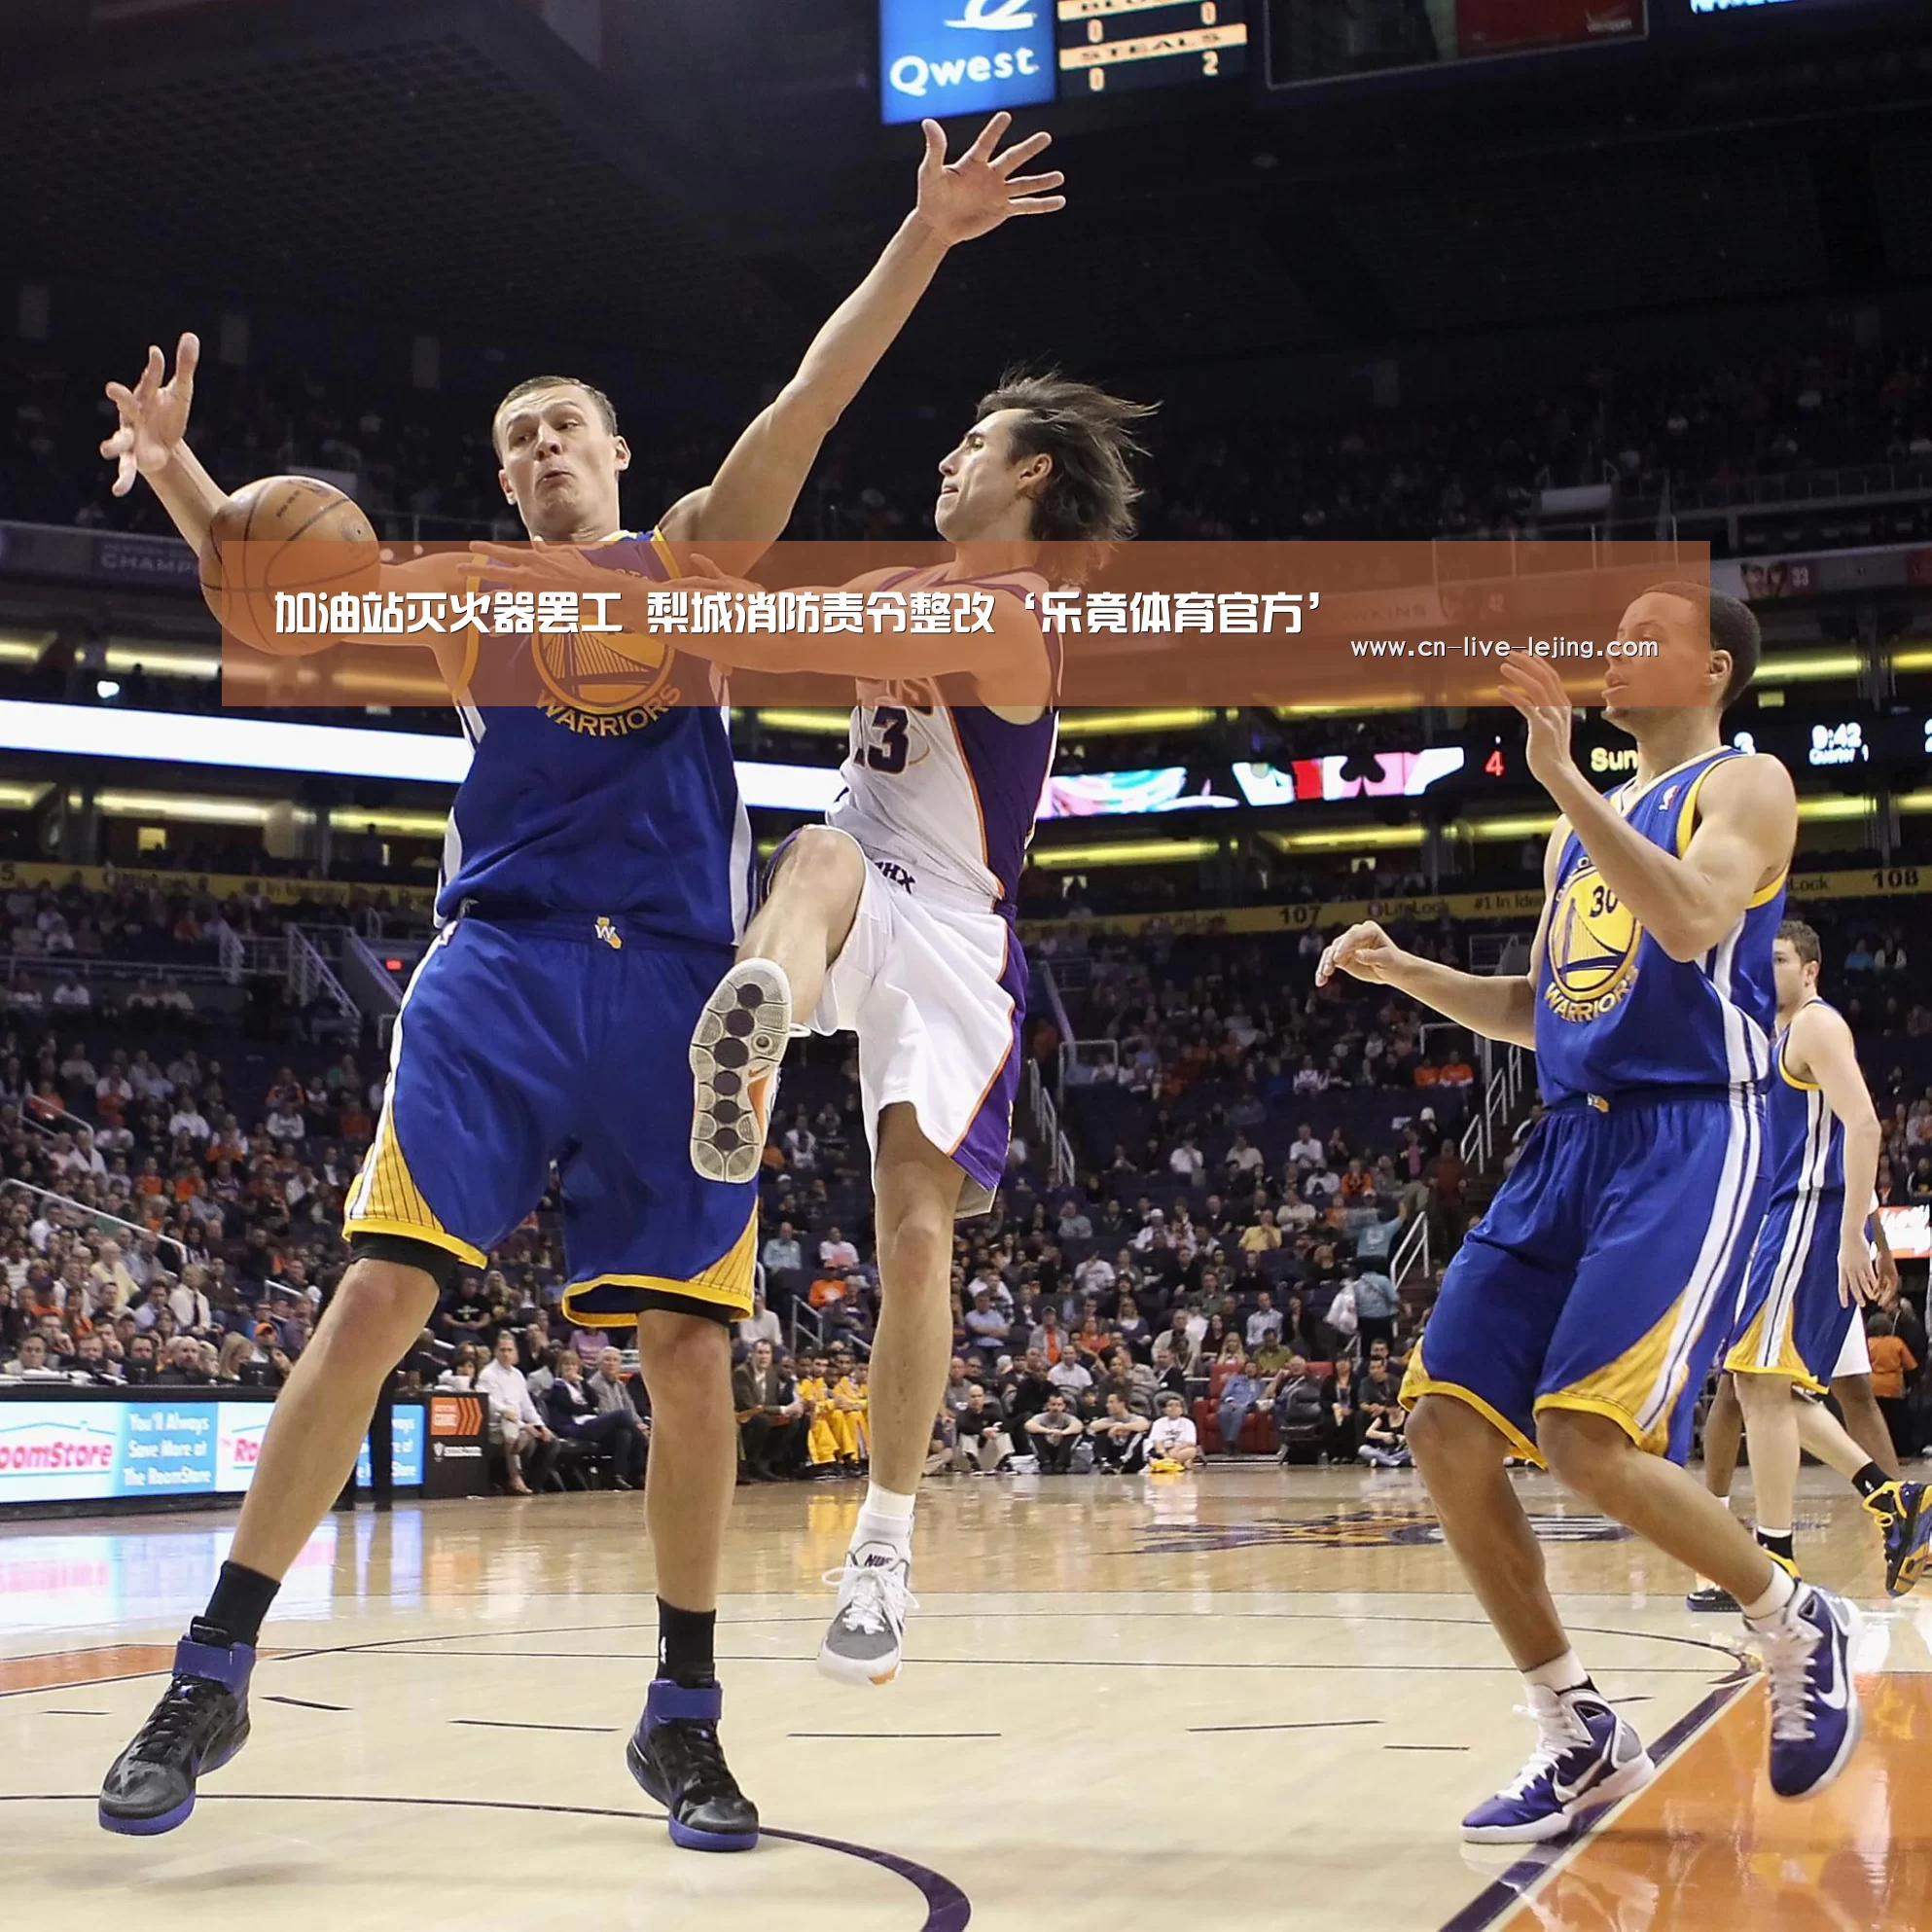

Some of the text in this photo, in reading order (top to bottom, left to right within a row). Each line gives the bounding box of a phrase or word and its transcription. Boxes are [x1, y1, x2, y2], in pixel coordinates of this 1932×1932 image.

[1081, 33, 1220, 60] STEALS
[889, 46, 1040, 97] Qwest
[1202, 51, 1219, 76] 2
[100, 553, 199, 574] CHAMP
[535, 684, 681, 737] WARRIORS
[1485, 750, 1505, 777] 4
[1872, 867, 1919, 889] 108
[1279, 905, 1322, 924] 107
[128, 1439, 160, 1458] Save
[161, 1439, 193, 1457] More
[124, 1464, 211, 1486] The RoomStore
